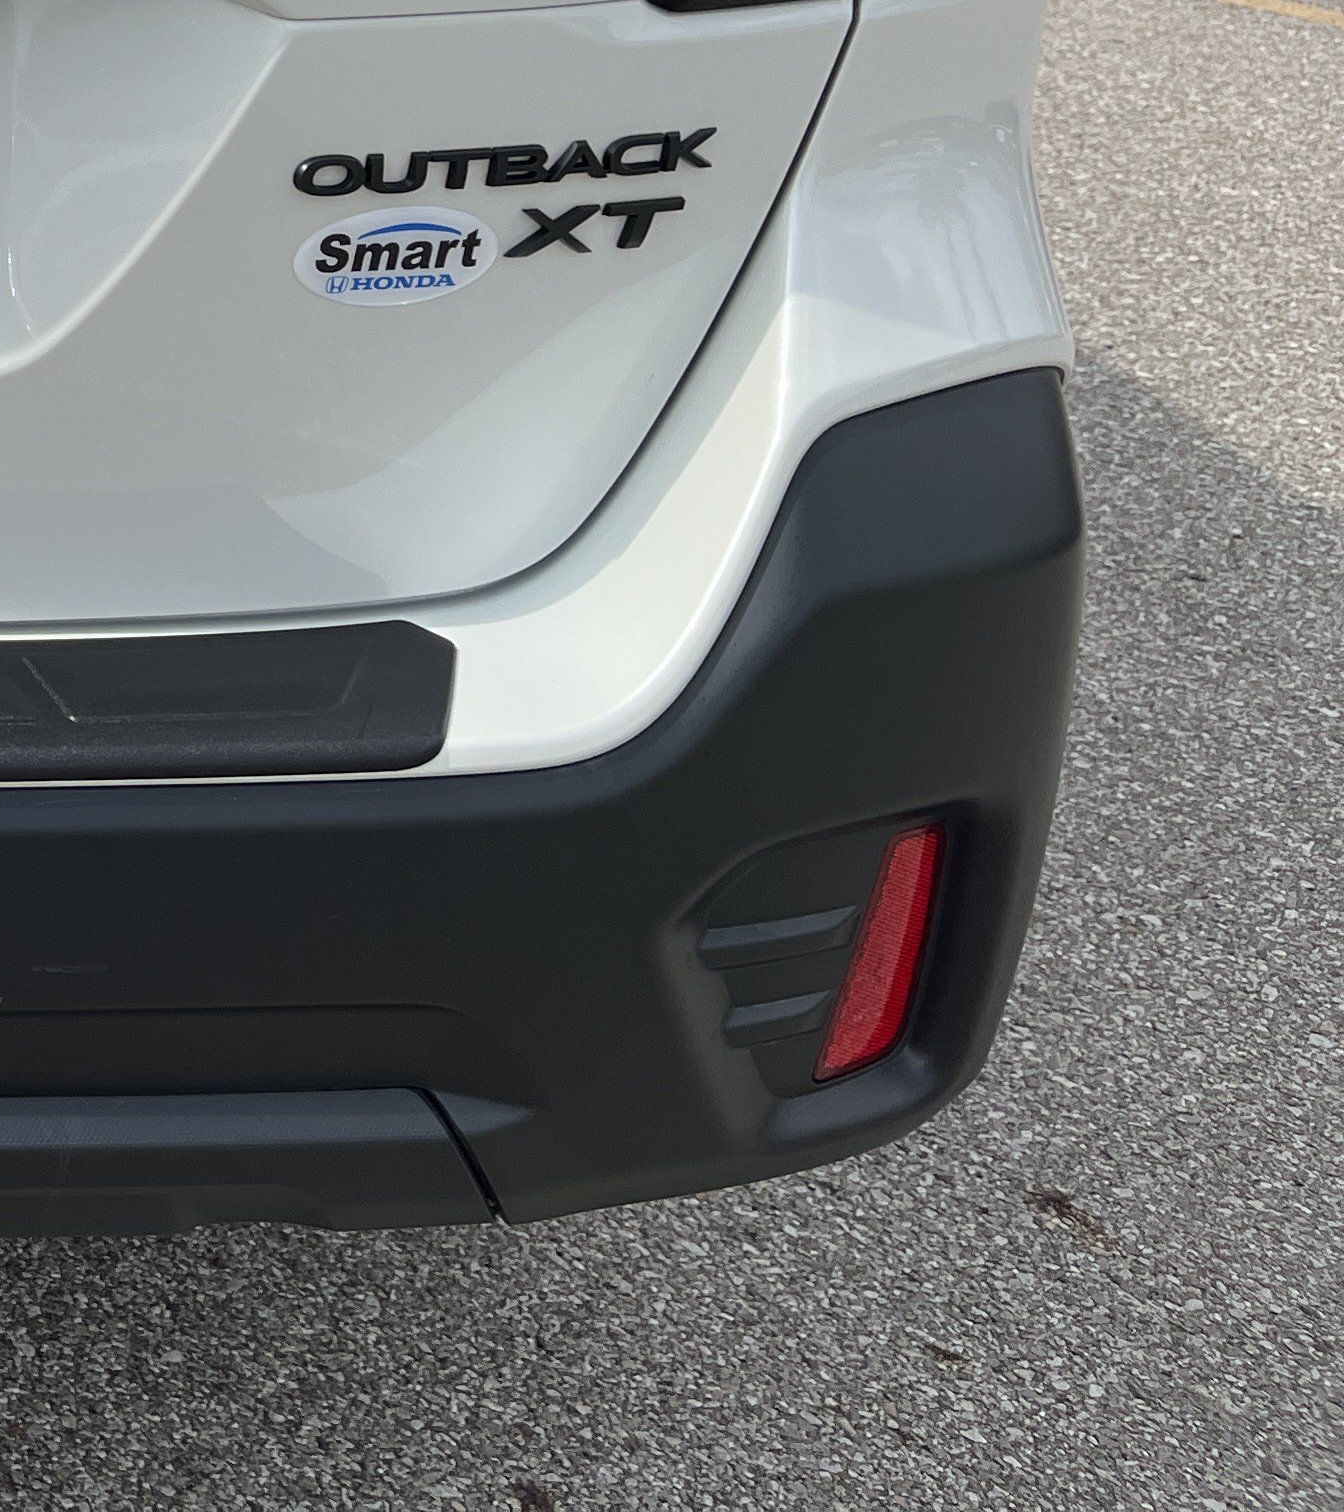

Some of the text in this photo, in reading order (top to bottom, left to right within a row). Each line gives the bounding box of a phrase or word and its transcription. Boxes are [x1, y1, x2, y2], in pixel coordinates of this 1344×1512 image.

[293, 127, 717, 196] OUTBACK
[315, 229, 481, 274] Smart
[503, 196, 685, 258] XT
[350, 273, 455, 291] HONDA
